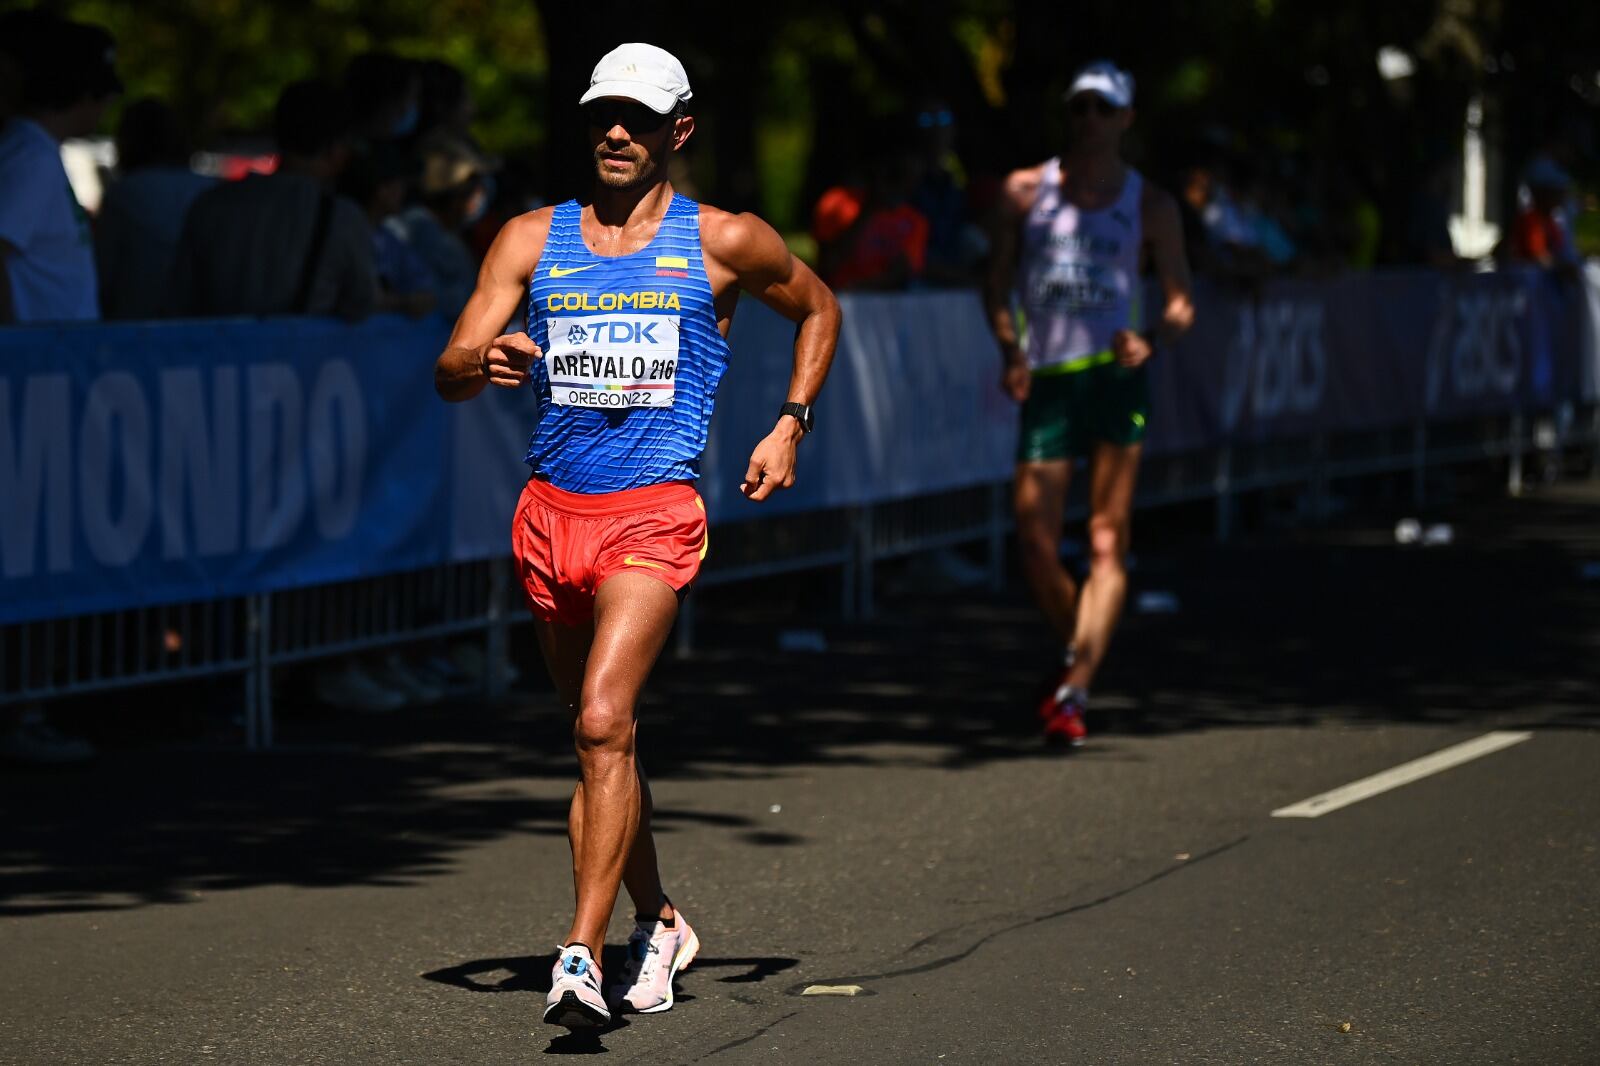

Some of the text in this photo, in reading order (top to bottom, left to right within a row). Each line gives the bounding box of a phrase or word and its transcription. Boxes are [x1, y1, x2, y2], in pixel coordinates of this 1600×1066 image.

[547, 292, 681, 312] COLOMBIA
[587, 321, 658, 344] TDK
[553, 351, 675, 380] ARÉVALO 216
[568, 391, 651, 406] OREGON22
